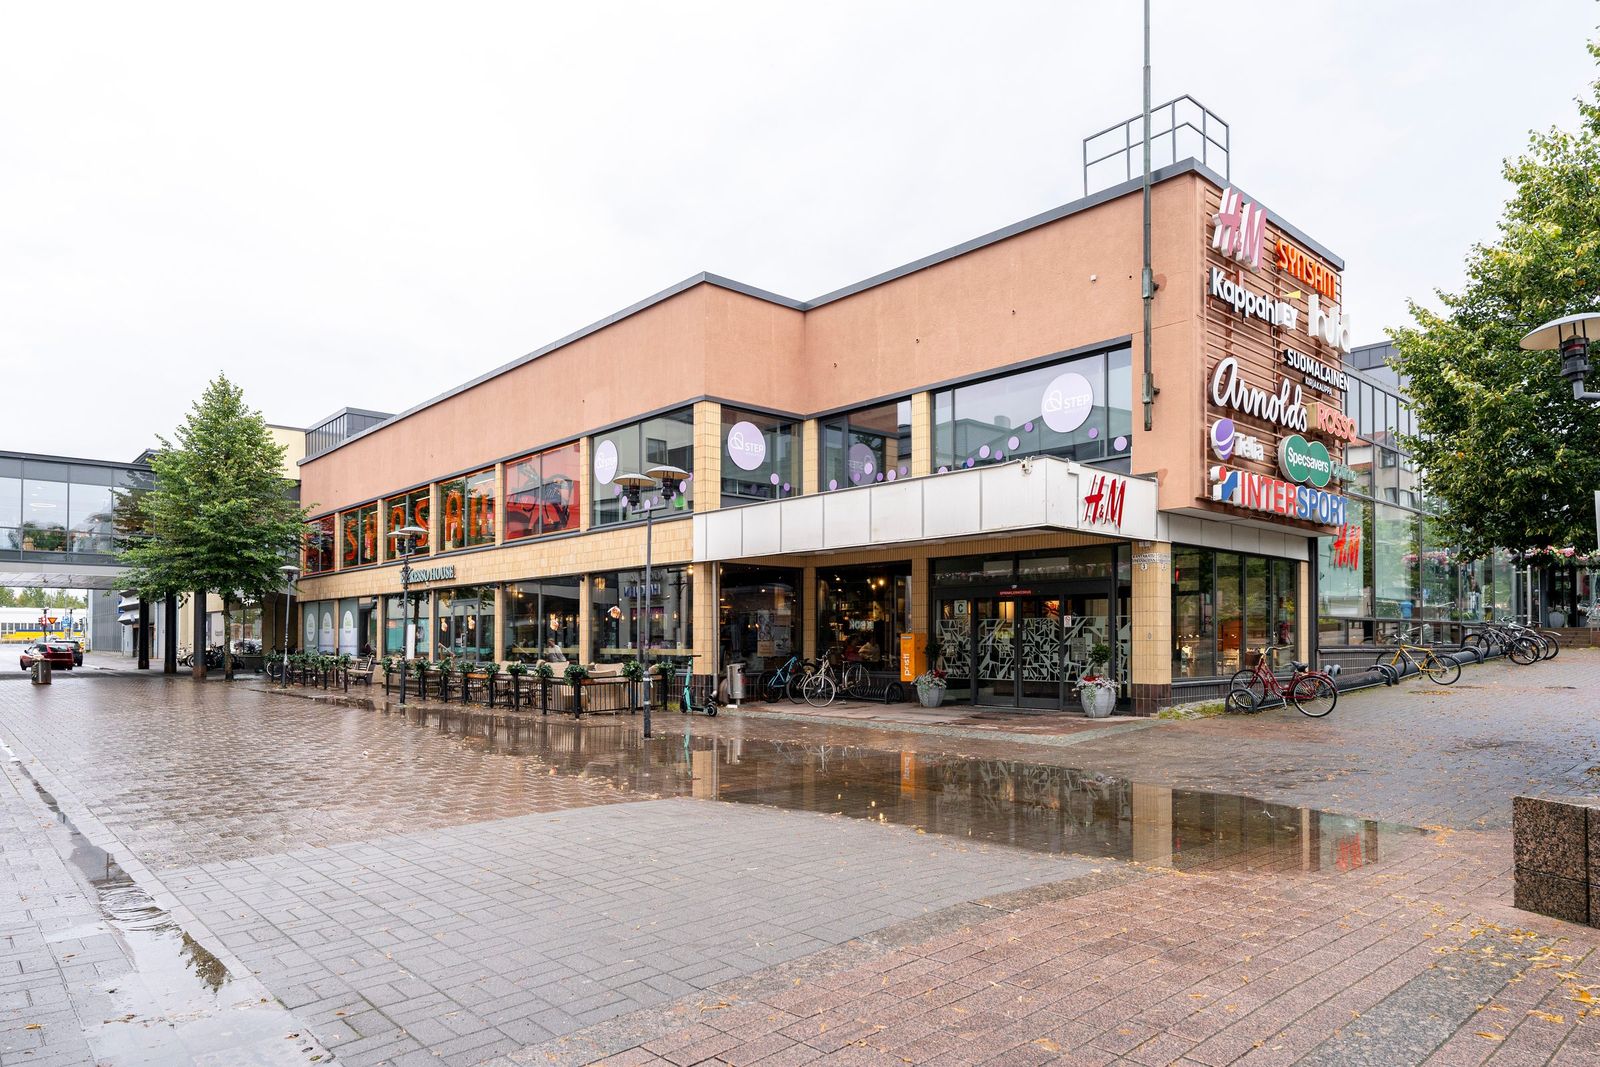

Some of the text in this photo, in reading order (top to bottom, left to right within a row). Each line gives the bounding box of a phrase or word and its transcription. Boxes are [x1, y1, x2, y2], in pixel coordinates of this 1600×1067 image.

[1212, 186, 1267, 272] H&M
[1286, 348, 1350, 392] SUOMALAINEN
[1064, 394, 1090, 409] STEP
[1211, 356, 1308, 433] Arnolds
[1317, 402, 1358, 443] ROSSO
[744, 442, 764, 452] STEP
[1287, 446, 1329, 473] Specsavers
[1084, 474, 1126, 529] H&M
[1240, 471, 1348, 526] INTERSPORT
